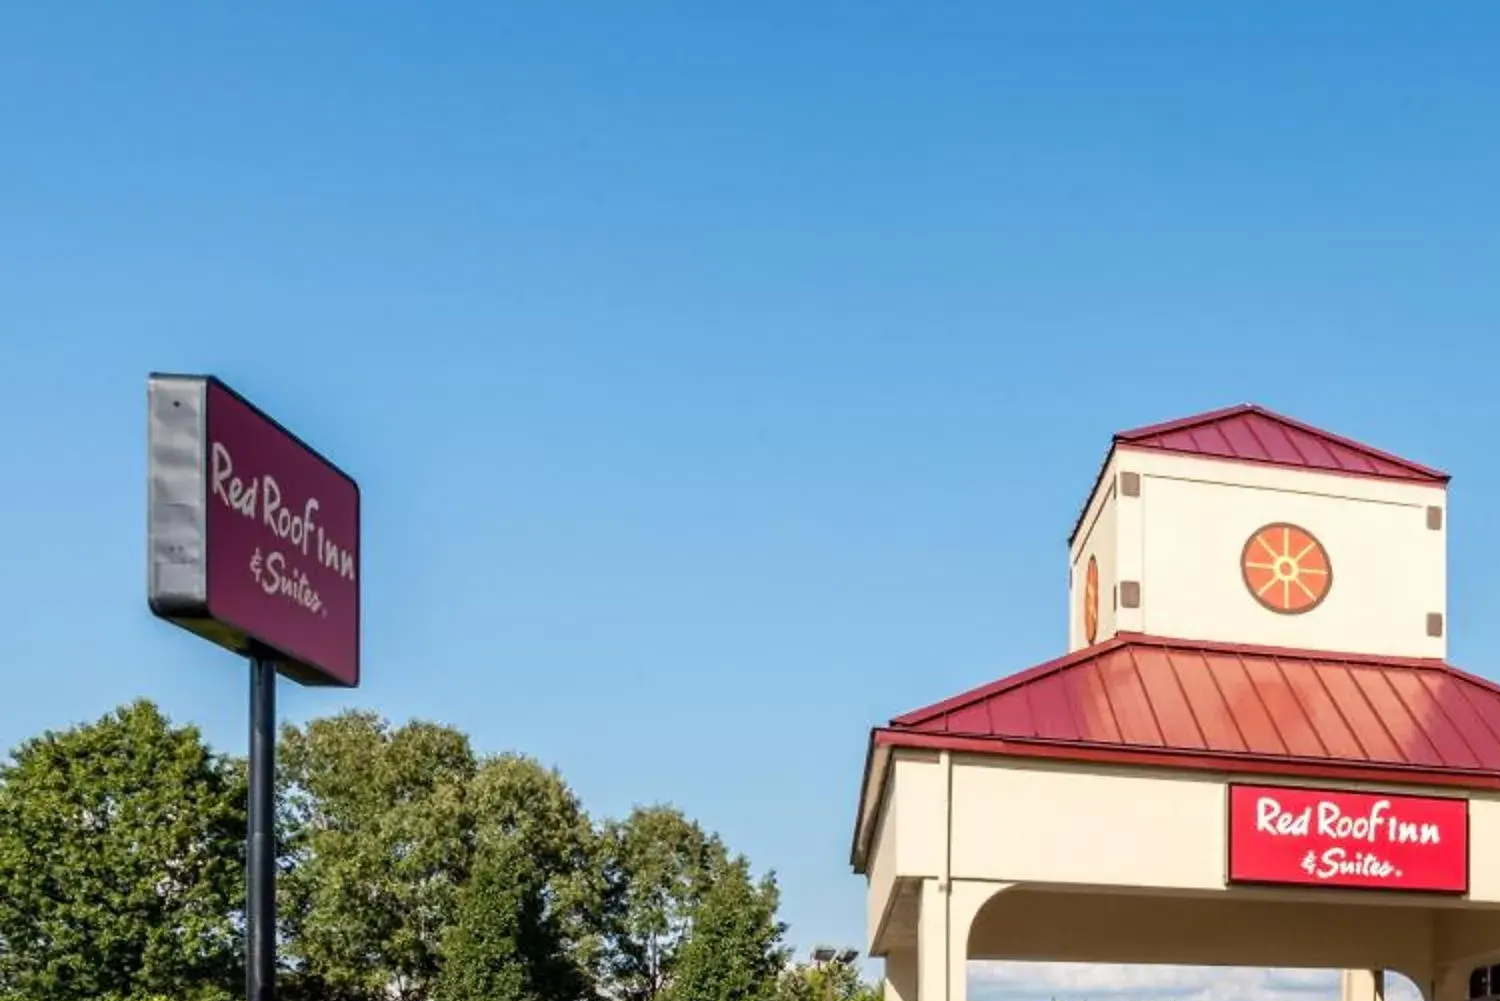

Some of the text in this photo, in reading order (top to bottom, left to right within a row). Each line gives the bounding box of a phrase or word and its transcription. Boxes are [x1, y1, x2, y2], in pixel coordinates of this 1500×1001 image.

[212, 442, 355, 581] Red Roof Inn
[250, 547, 321, 614] & Suites
[1256, 797, 1441, 844] Red Roof Inn
[1300, 847, 1394, 878] & Suites
